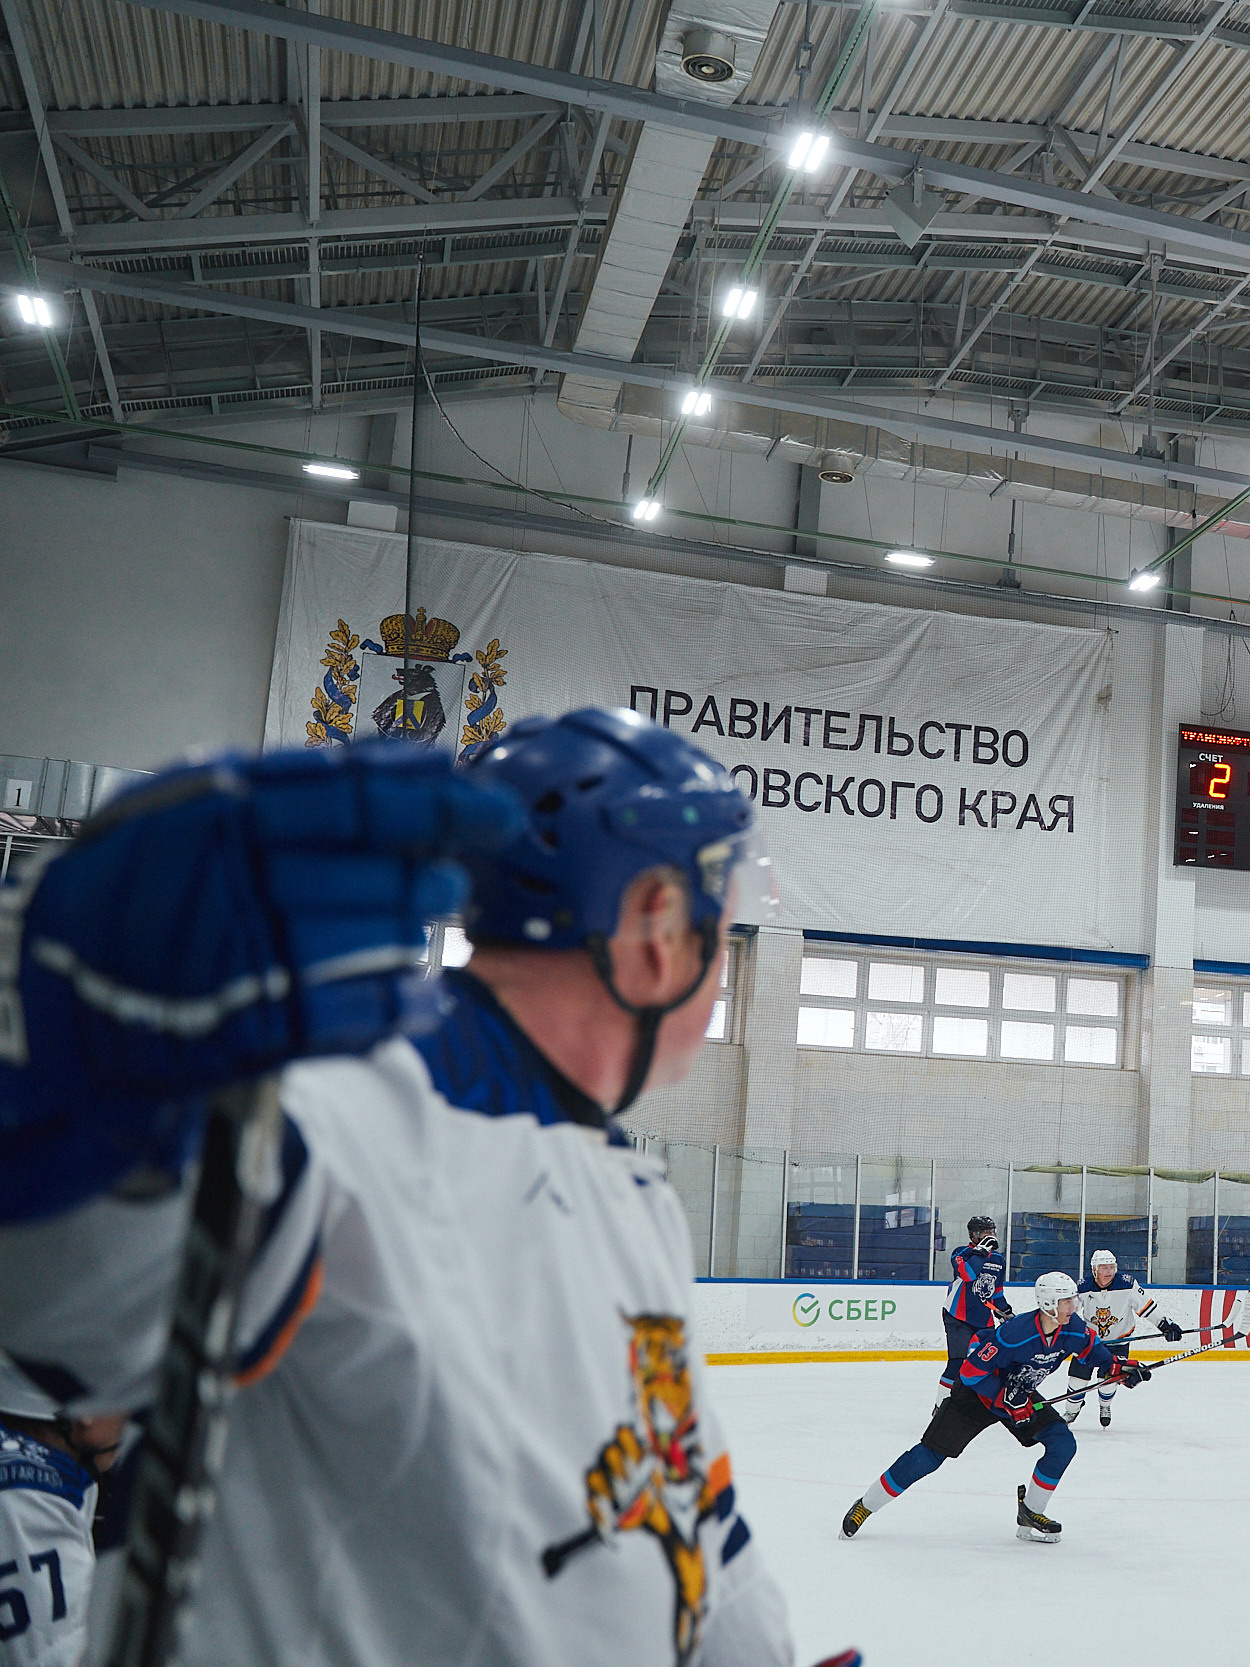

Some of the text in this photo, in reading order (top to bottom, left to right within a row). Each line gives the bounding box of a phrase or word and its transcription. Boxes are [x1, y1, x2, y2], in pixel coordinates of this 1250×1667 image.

[630, 685, 1029, 768] ПРАВИТЕЛЬСТВО
[1198, 752, 1224, 763] СЧЕТ
[1208, 763, 1231, 798] 2
[14, 787, 22, 807] 1
[1192, 802, 1224, 810] УДАЛЕНИЯ
[958, 787, 1075, 833] КРАЯ
[828, 1299, 897, 1321] СБЕР
[977, 1341, 998, 1362] 13
